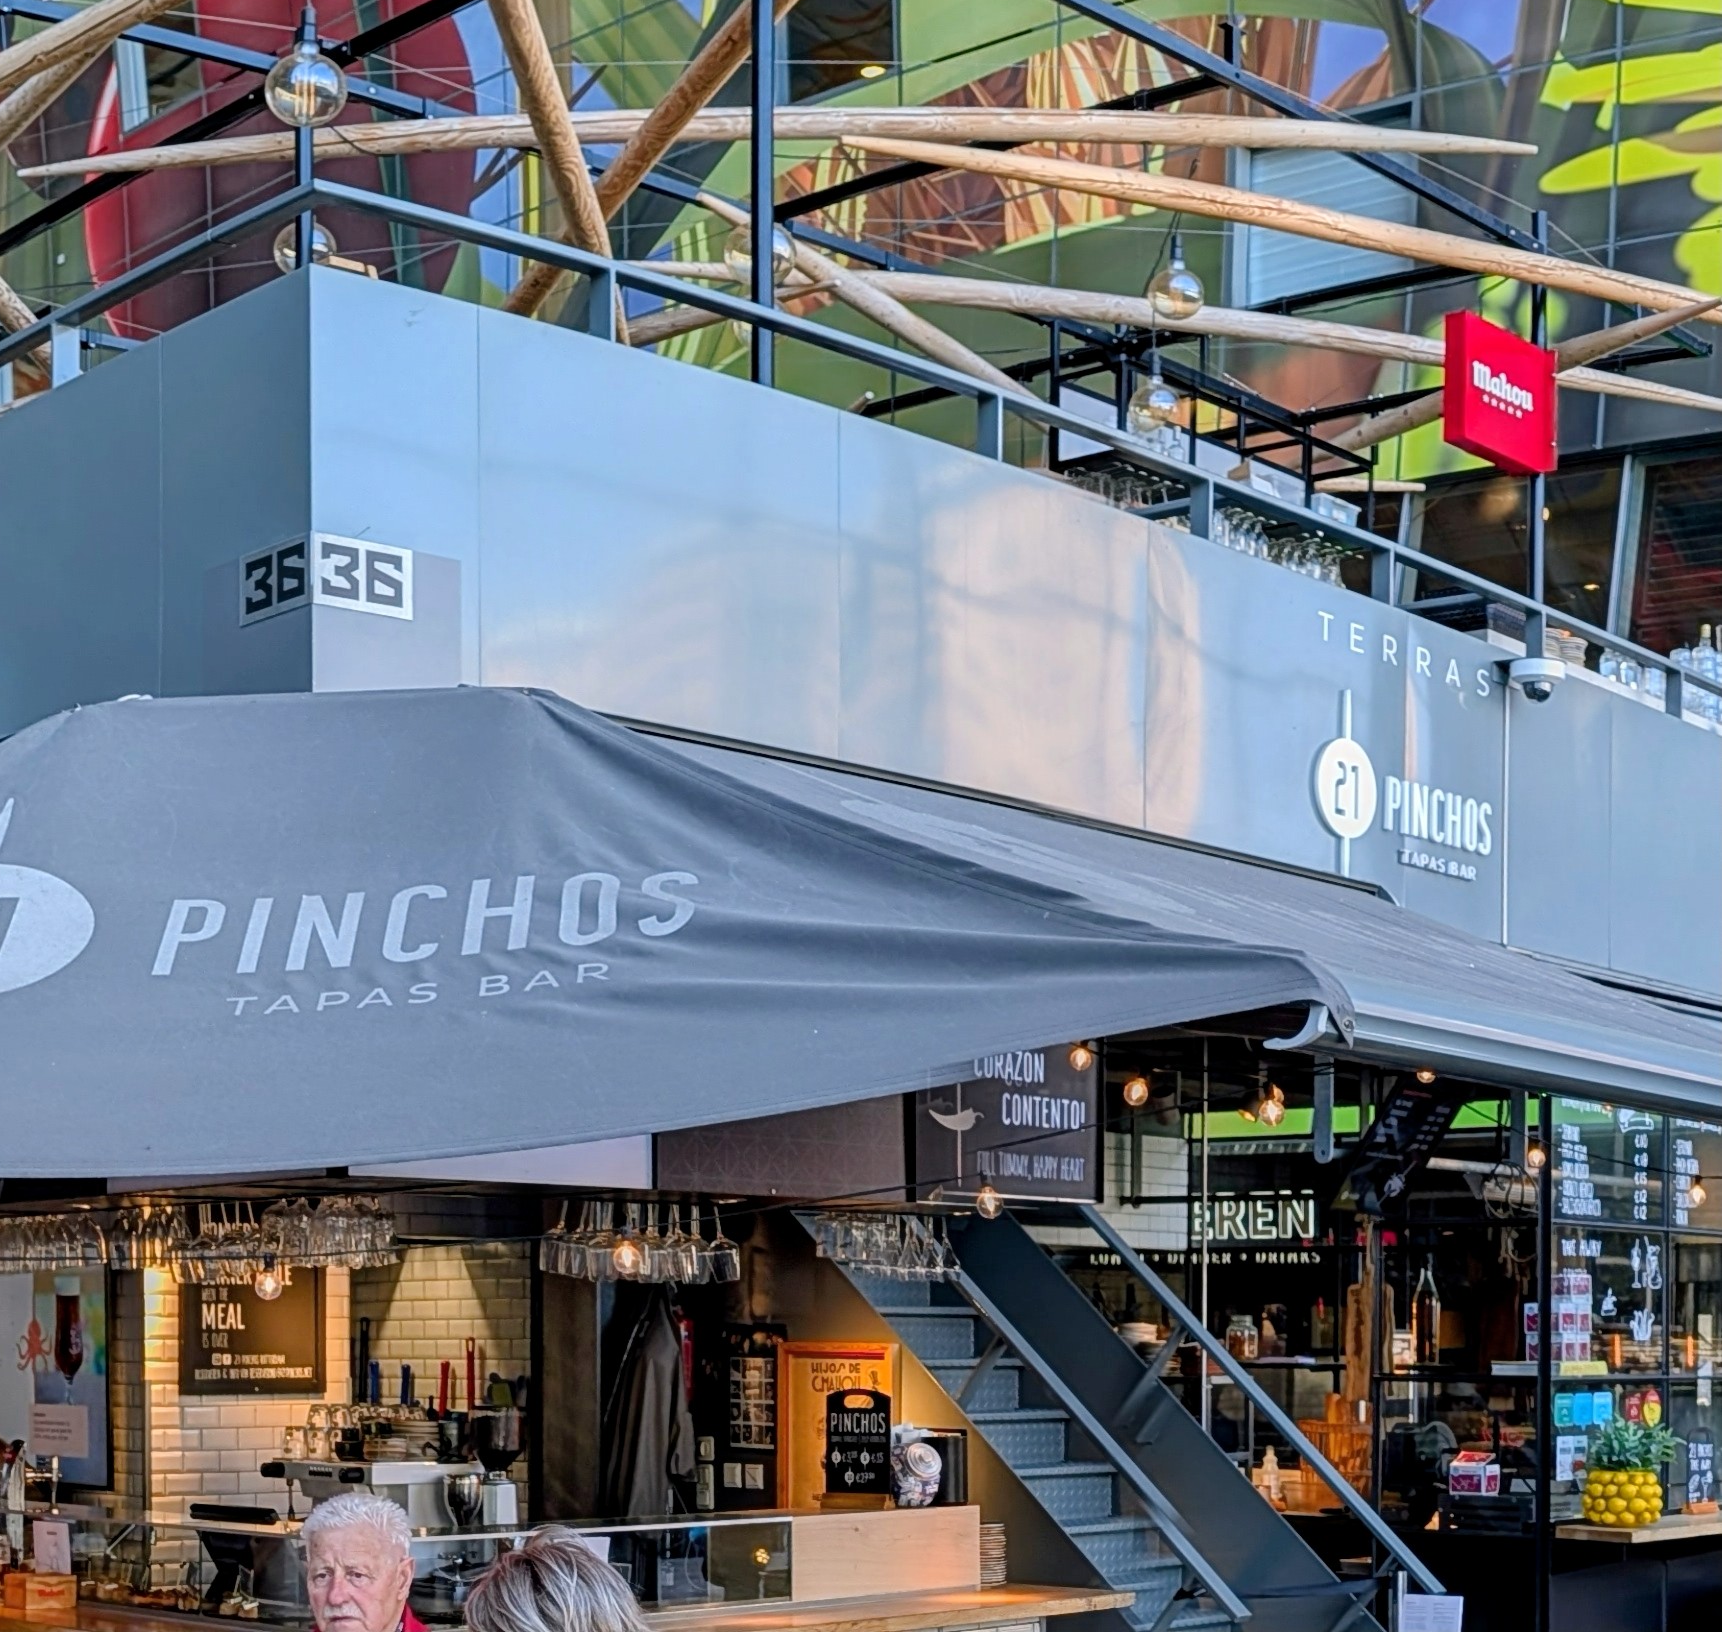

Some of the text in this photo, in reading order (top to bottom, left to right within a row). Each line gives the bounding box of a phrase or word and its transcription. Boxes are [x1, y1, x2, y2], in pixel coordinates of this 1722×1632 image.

[1473, 358, 1534, 412] Mahou
[243, 541, 306, 616] 36
[320, 540, 405, 608] 36
[1318, 610, 1491, 697] TERRAS
[1334, 760, 1360, 821] 21
[1383, 775, 1493, 857] PINCHOS
[1399, 848, 1477, 882] TAPAS BAR
[150, 870, 702, 977] PINCHOS
[226, 961, 611, 1017] TAPAS BAR
[1002, 1092, 1086, 1133] CONTENTO!
[999, 1151, 1032, 1181] TUMMY,
[1033, 1155, 1058, 1181] HAPPY
[1060, 1157, 1085, 1182] HEART
[202, 1303, 246, 1330] MEAL
[849, 1363, 861, 1374] DE
[830, 1413, 886, 1433] PINCHOS
